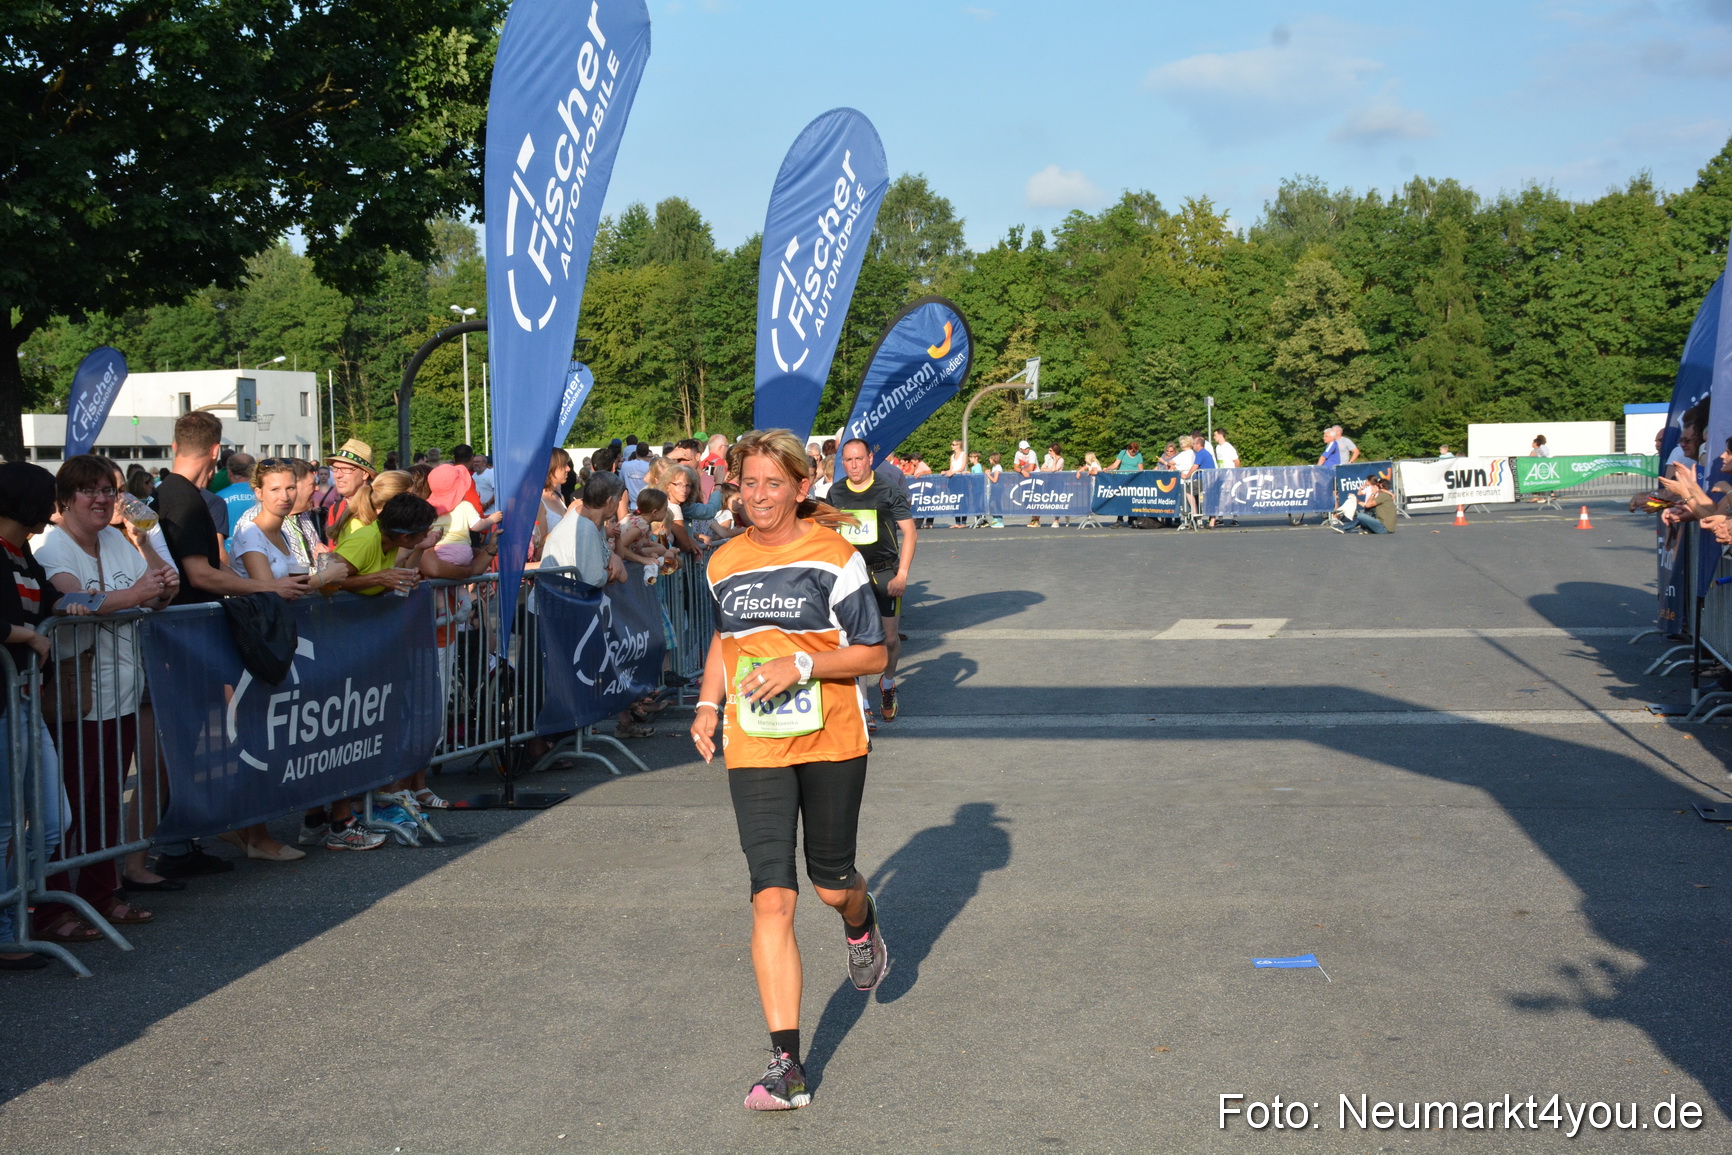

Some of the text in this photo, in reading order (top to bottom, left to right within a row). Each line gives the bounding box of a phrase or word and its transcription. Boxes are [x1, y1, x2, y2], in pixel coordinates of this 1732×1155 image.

[527, 0, 606, 286] Fischer
[560, 49, 620, 281] AUTOMOBILE
[788, 149, 856, 341] Fischer
[814, 182, 866, 338] AUTOMOBILE
[80, 361, 115, 430] Fischer
[560, 373, 581, 416] cher
[904, 387, 927, 411] Druck
[940, 352, 966, 382] Medien
[91, 374, 119, 429] AUTOMOBILE
[560, 383, 585, 426] AUTOMOBILE
[851, 361, 936, 439] Frischmann
[1340, 477, 1367, 492] Frisch
[1444, 468, 1488, 490] swn
[1525, 461, 1561, 481] AOK
[911, 490, 964, 506] Fischer
[916, 504, 960, 512] AUTOMOBILE
[1022, 489, 1074, 503] Fischer
[1097, 485, 1158, 499] Frischmann
[1131, 497, 1147, 505] Druck
[1246, 485, 1314, 500] Fischer
[1252, 500, 1309, 508] AUTOMOBILE
[733, 593, 807, 611] Fischer
[740, 611, 801, 620] AUTOMOBILE
[267, 677, 393, 751] Fischer
[281, 734, 383, 784] AUTOMOBILE
